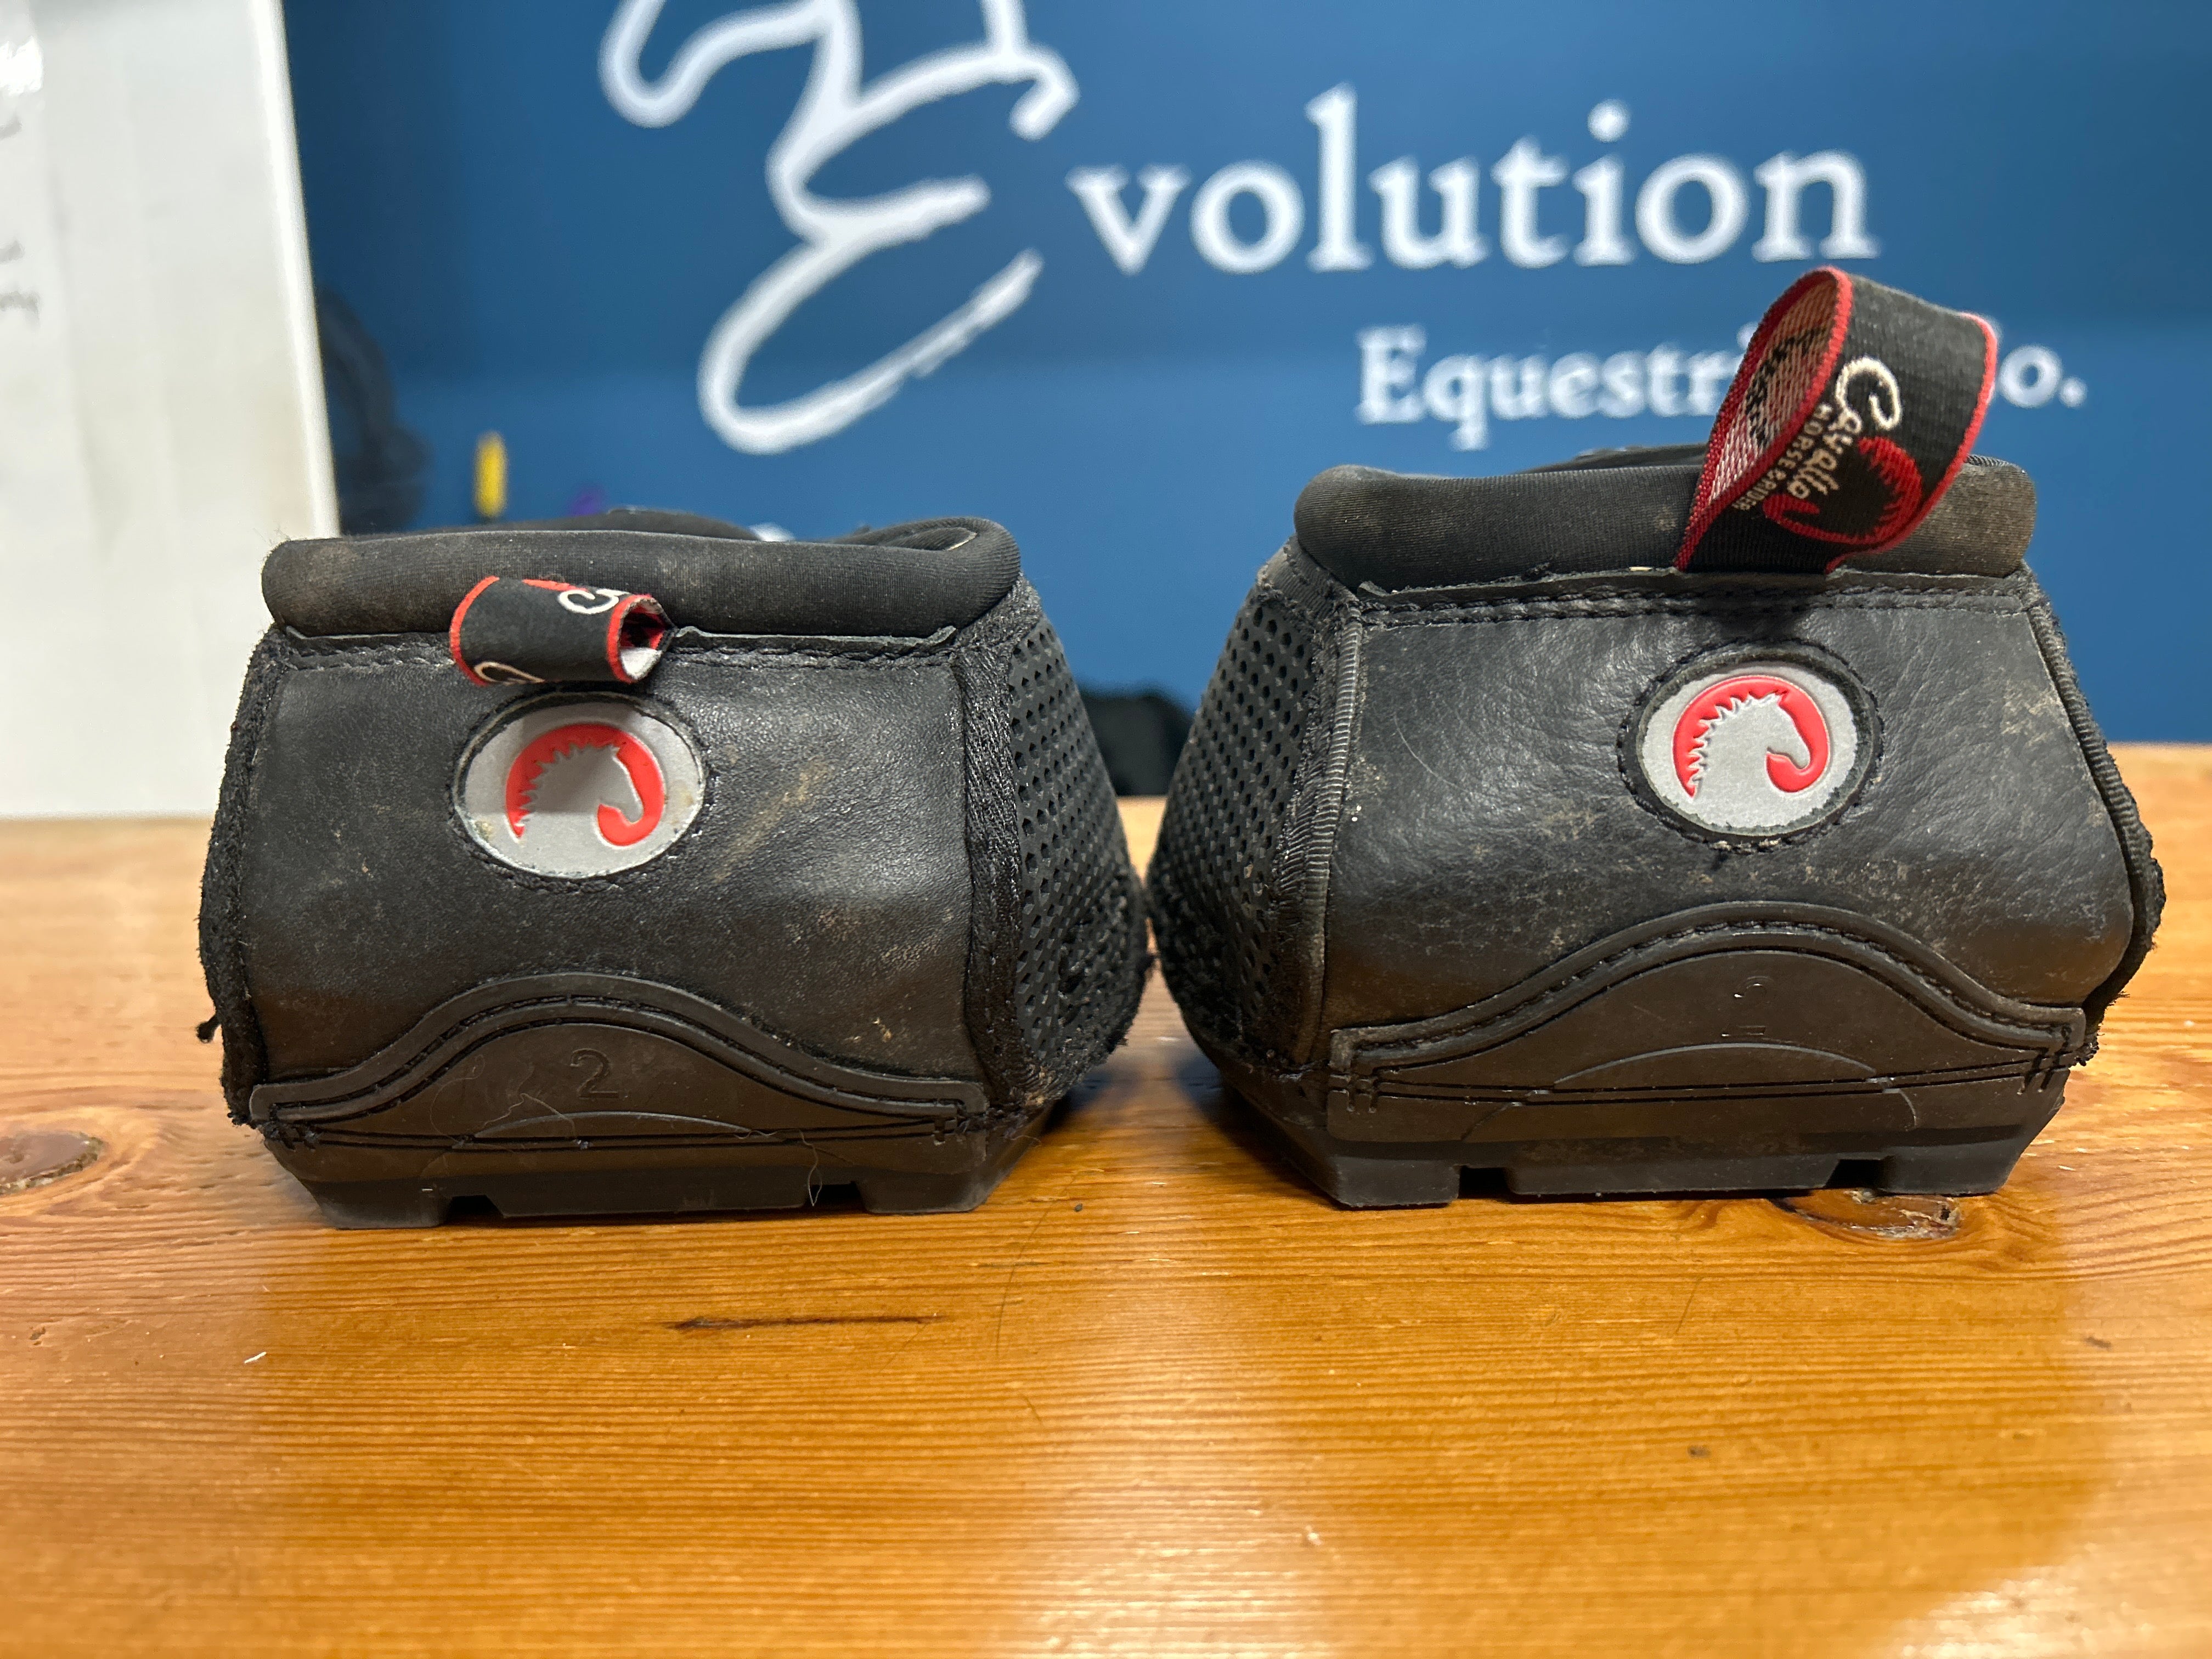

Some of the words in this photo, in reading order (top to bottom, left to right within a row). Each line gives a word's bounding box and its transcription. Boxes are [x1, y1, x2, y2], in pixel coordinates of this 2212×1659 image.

[1999, 341, 2087, 410] o.
[1777, 402, 1833, 470] HORSE
[1787, 356, 1903, 500] Cavallo
[569, 1047, 620, 1100] 2
